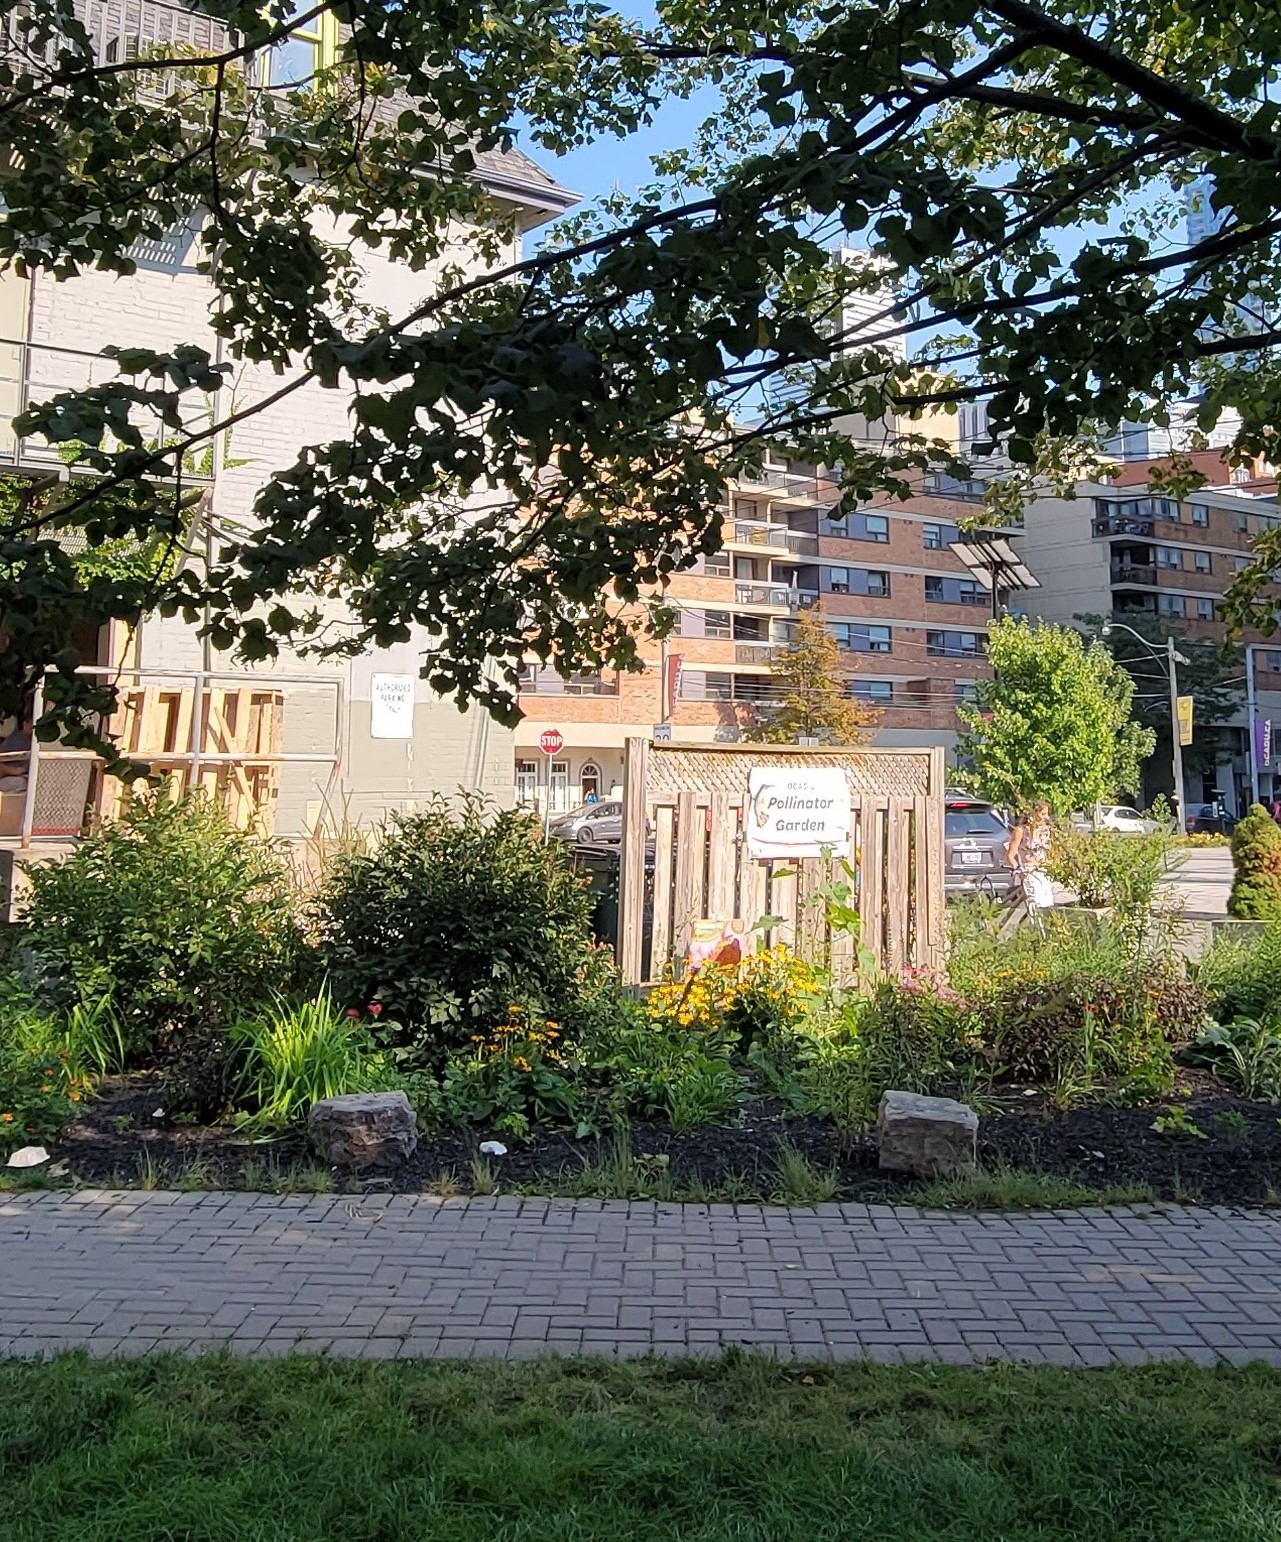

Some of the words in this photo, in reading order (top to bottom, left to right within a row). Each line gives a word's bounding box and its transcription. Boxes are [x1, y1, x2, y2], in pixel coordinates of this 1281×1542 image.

[541, 735, 563, 747] STOP
[767, 795, 834, 809] Pollinator
[775, 818, 825, 831] Garden
